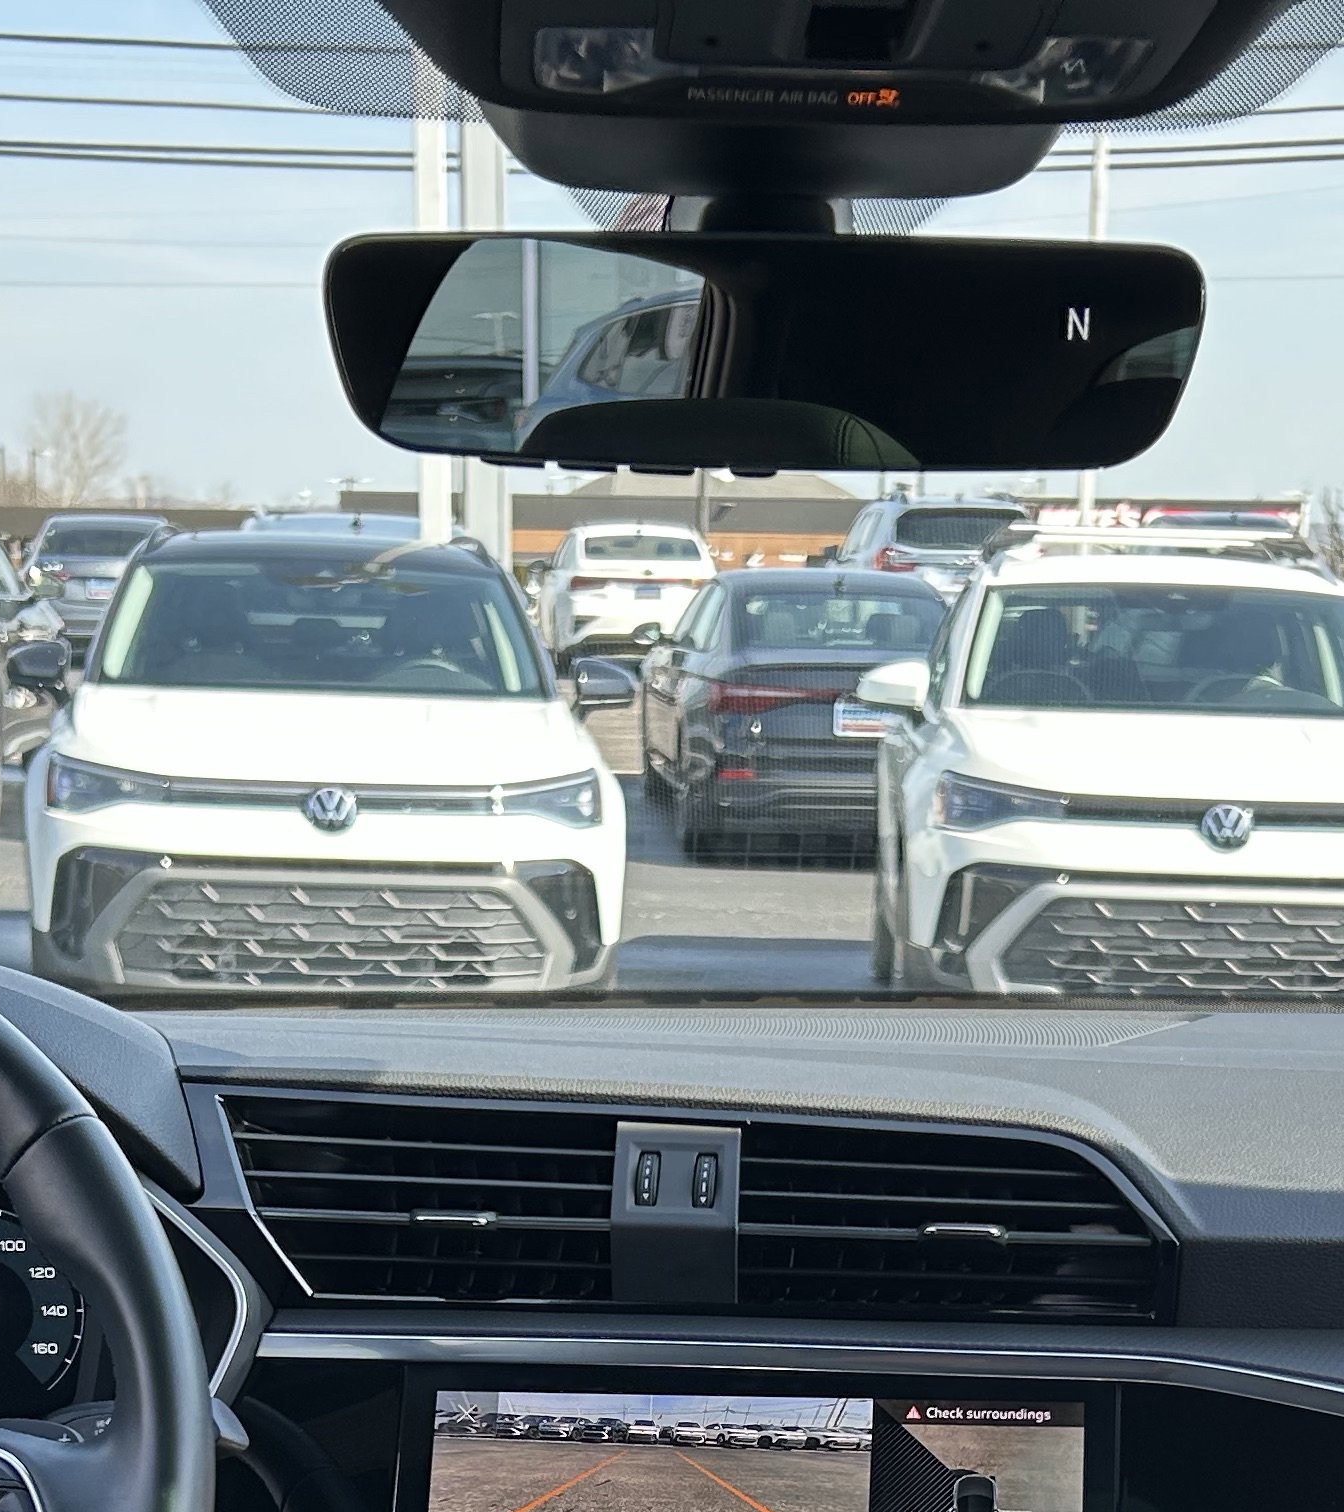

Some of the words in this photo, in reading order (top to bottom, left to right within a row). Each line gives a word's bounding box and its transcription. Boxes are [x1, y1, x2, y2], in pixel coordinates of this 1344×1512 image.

[687, 87, 775, 104] PASSENGER
[778, 93, 804, 105] AIR
[807, 92, 838, 105] BAG
[847, 92, 877, 105] OFF
[1067, 307, 1090, 341] N
[28, 1266, 56, 1279] 120
[40, 1305, 68, 1317] 140
[31, 1343, 58, 1355] 160
[926, 1406, 964, 1420] Check
[966, 1408, 1052, 1424] surroundings
